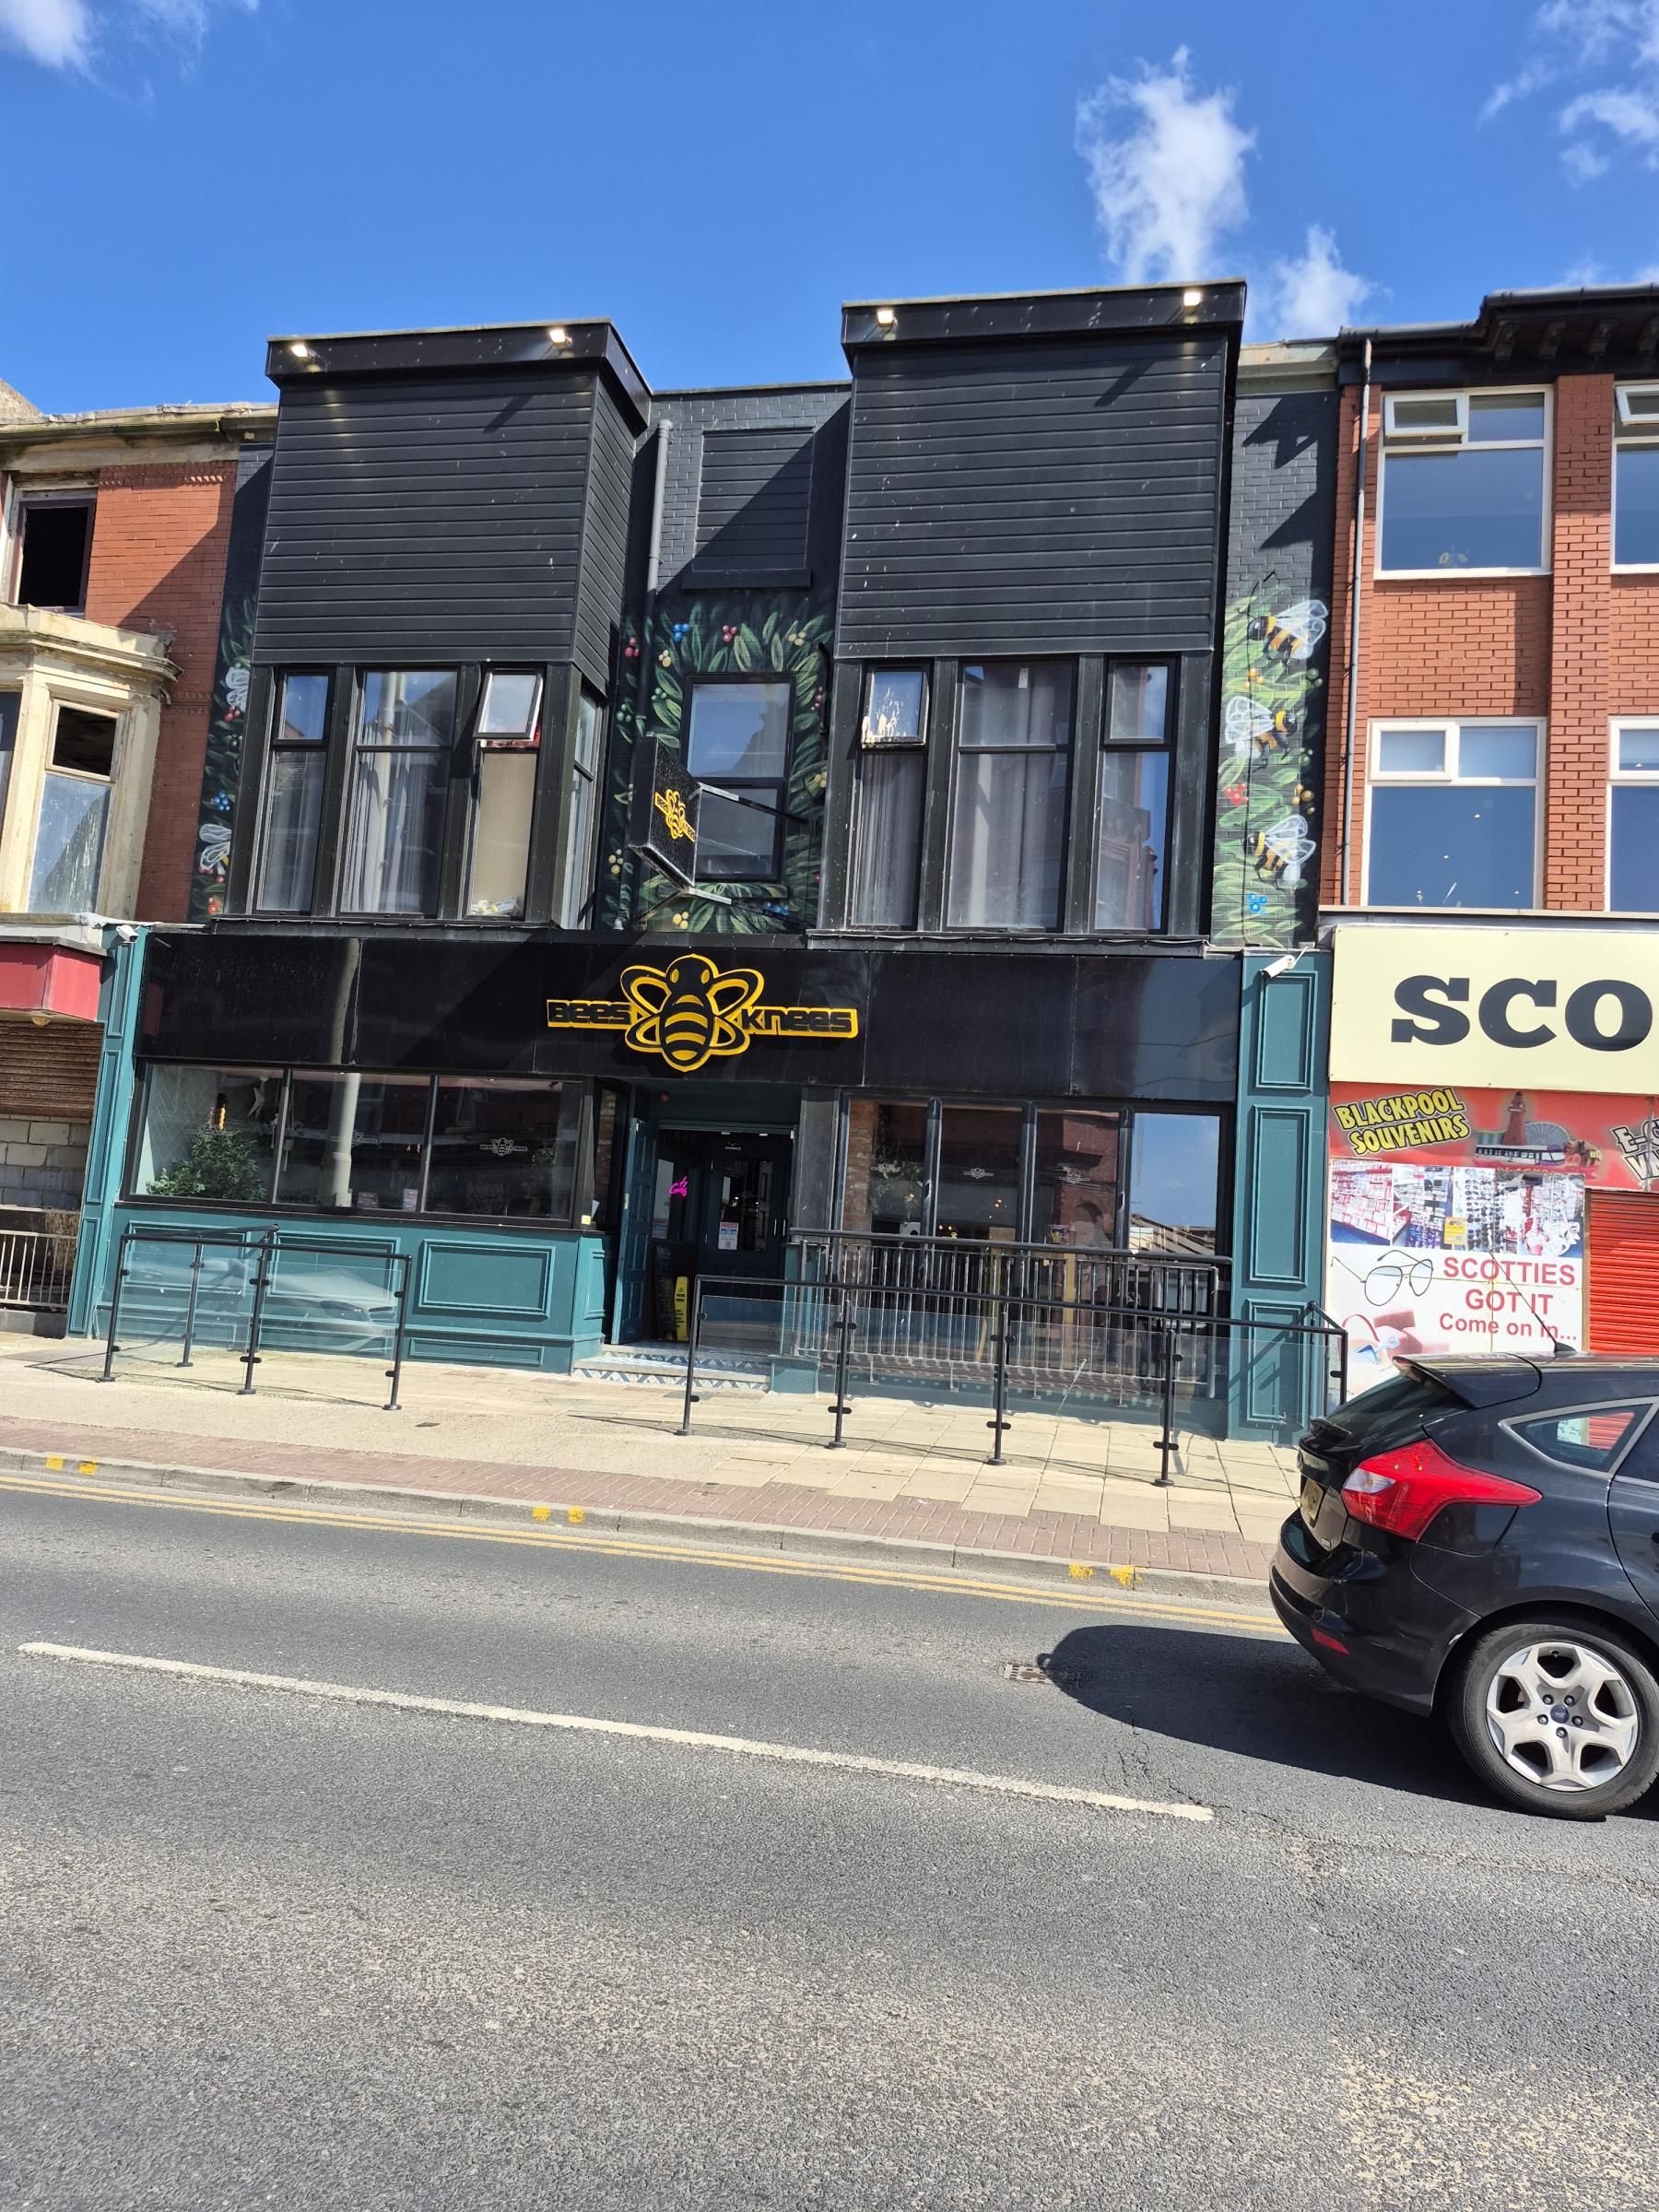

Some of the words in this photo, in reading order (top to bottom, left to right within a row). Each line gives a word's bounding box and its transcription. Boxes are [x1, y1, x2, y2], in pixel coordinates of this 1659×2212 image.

[1392, 975, 1653, 1052] SCO
[1334, 1088, 1465, 1129] BLACKPOOL
[1349, 1113, 1470, 1154] SOUVENIRS
[1443, 1256, 1575, 1286] SCOTTIES
[1465, 1288, 1522, 1313] GOT
[1531, 1293, 1554, 1315] IT
[1440, 1312, 1500, 1334] Come
[1507, 1322, 1532, 1336] on
